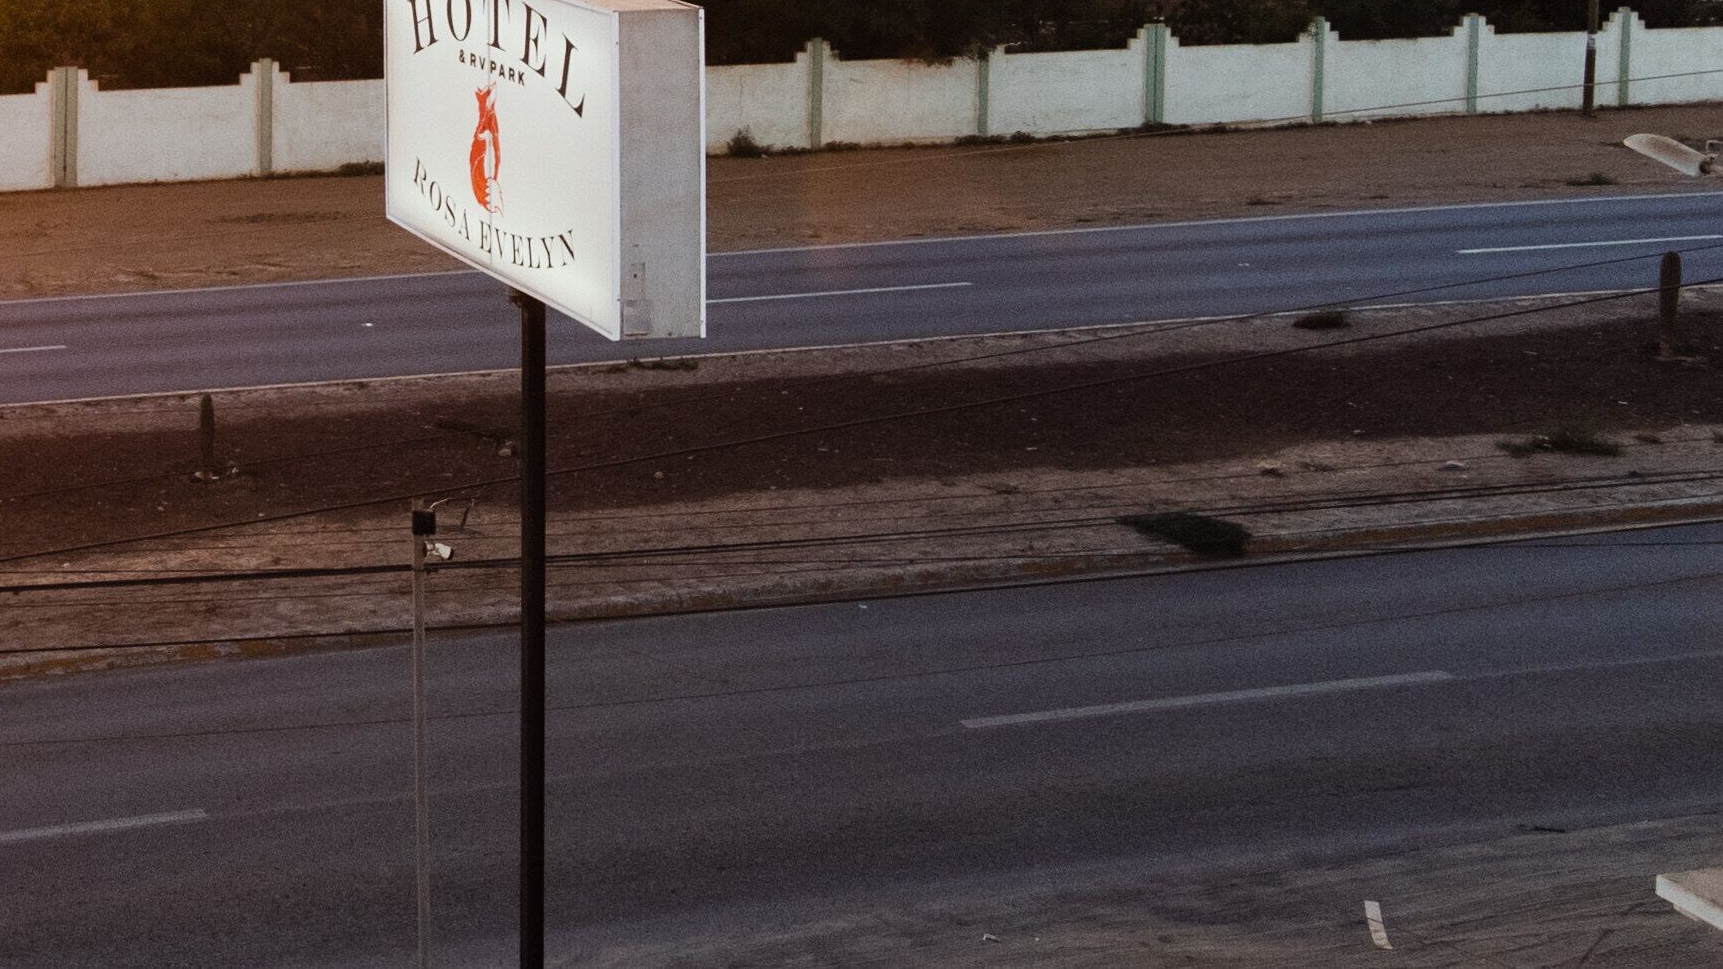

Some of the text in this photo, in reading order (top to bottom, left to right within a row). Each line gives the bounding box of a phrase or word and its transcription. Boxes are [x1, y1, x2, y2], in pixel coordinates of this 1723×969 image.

[458, 49, 525, 87] & RV PARK
[414, 156, 576, 269] ROSA EVELYN
